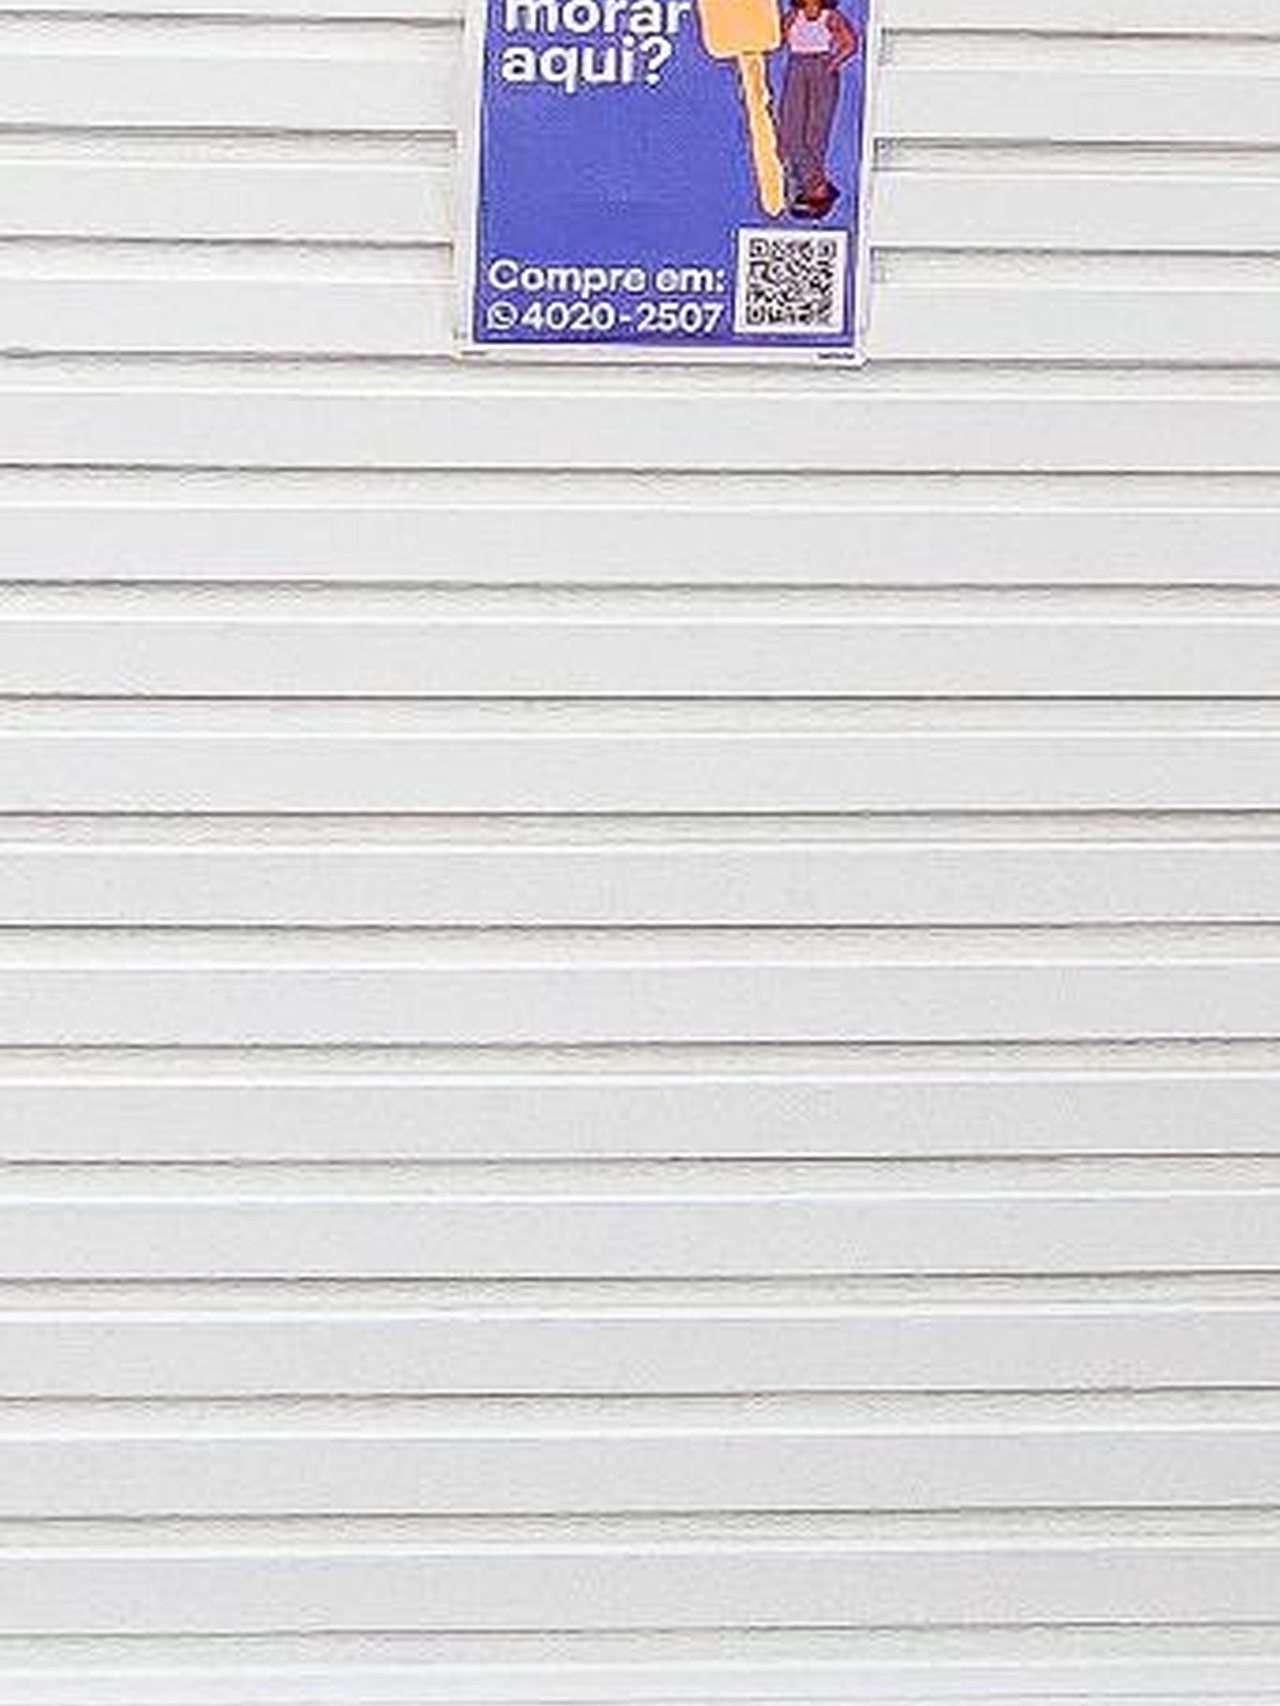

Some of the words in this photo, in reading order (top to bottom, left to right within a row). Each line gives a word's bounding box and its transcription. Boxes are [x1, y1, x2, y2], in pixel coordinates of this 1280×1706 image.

[501, 35, 673, 93] aqui?
[488, 259, 647, 299] Compre
[655, 267, 726, 293] em:
